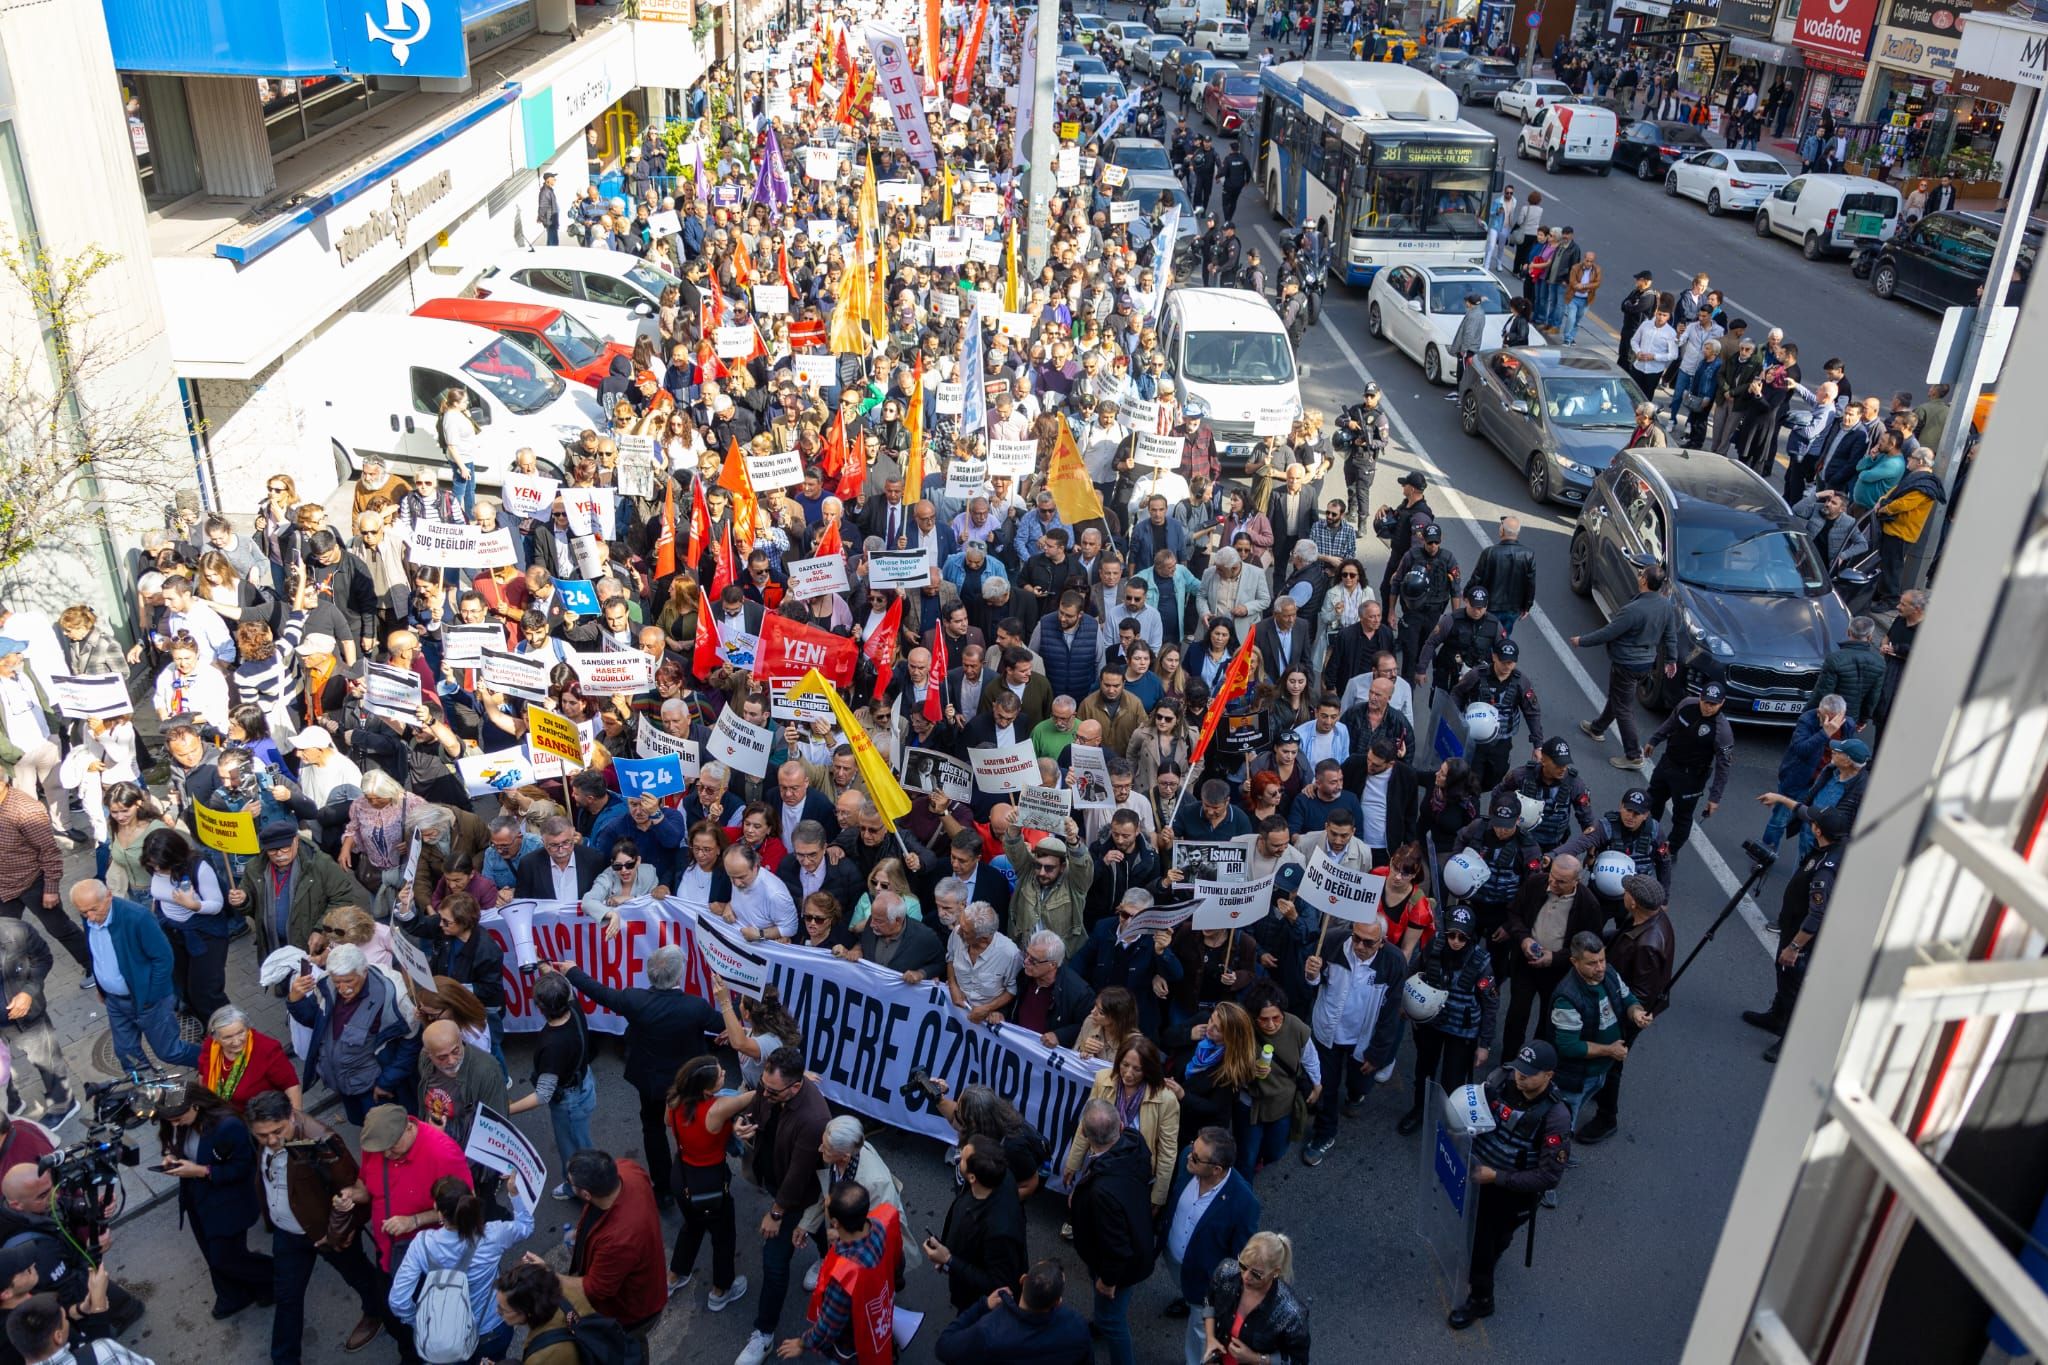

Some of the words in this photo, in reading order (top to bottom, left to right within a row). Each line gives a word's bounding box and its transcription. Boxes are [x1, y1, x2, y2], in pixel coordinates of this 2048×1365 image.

[1803, 17, 1862, 45] vodafone
[514, 486, 542, 503] YENİ
[575, 500, 602, 516] YENİ
[416, 534, 432, 551] SUÇ
[434, 536, 477, 551] DEĞİLDİR!
[875, 559, 899, 567] Whose
[900, 557, 920, 566] house
[784, 637, 827, 666] YENİ
[581, 658, 615, 666] SANSÜRE
[617, 657, 640, 665] HAYIR
[591, 674, 635, 683] ÖZGÜRLÜK!
[1759, 701, 1770, 710] 06
[1774, 702, 1786, 711] GC
[543, 717, 554, 726] EN
[536, 735, 583, 762] SANSÜR
[737, 735, 752, 748] VAR
[626, 768, 673, 789] T24
[938, 761, 971, 781] HÜSEYİN
[943, 773, 968, 788] AYKAN
[1210, 847, 1243, 862] İSMAİL
[1226, 862, 1242, 874] ARI
[1321, 859, 1363, 885] GAZETECİLİK
[1199, 884, 1229, 896] TUTUKLU
[1230, 878, 1273, 895] GAZETECİLERE
[1307, 865, 1324, 889] SUÇ
[1323, 877, 1377, 905] DEĞİLDİR!
[1219, 896, 1255, 907] ÖZGÜRLÜK!
[709, 943, 743, 970] Sansüre
[716, 959, 729, 970] var
[730, 967, 759, 983] canım!
[479, 1119, 506, 1139] We're
[506, 1135, 541, 1185] journalists,
[487, 1135, 506, 1152] not
[507, 1148, 534, 1183] parrots
